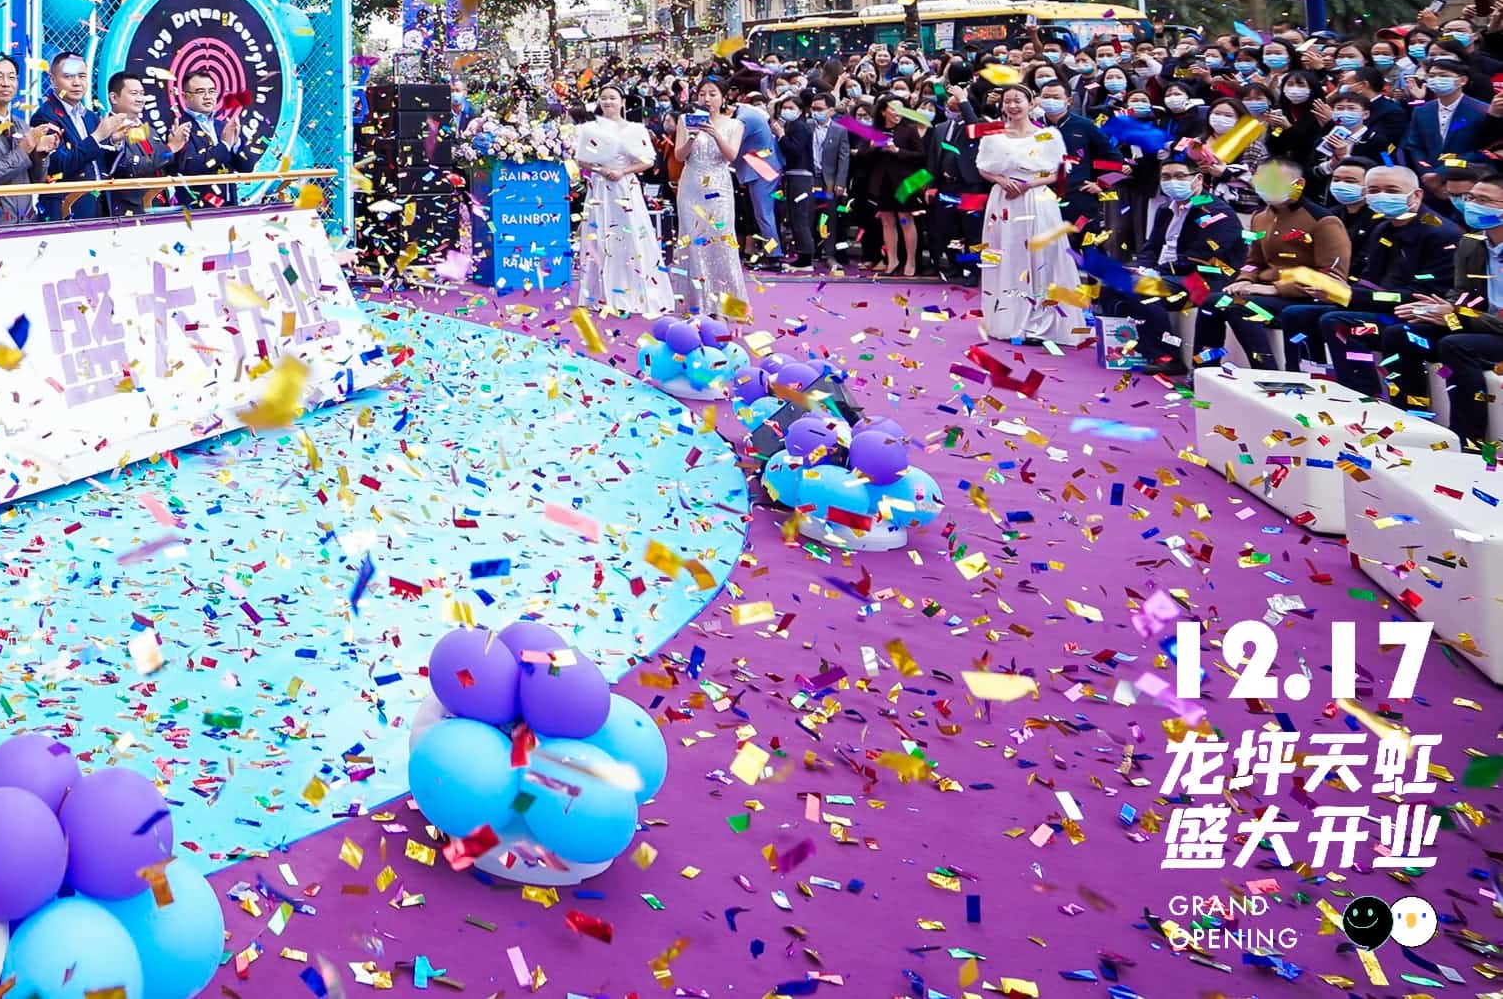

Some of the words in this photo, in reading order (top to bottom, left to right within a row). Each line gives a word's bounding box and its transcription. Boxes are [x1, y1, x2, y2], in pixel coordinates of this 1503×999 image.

[501, 212, 562, 225] RAINBOW
[41, 240, 341, 409] 盛大开业
